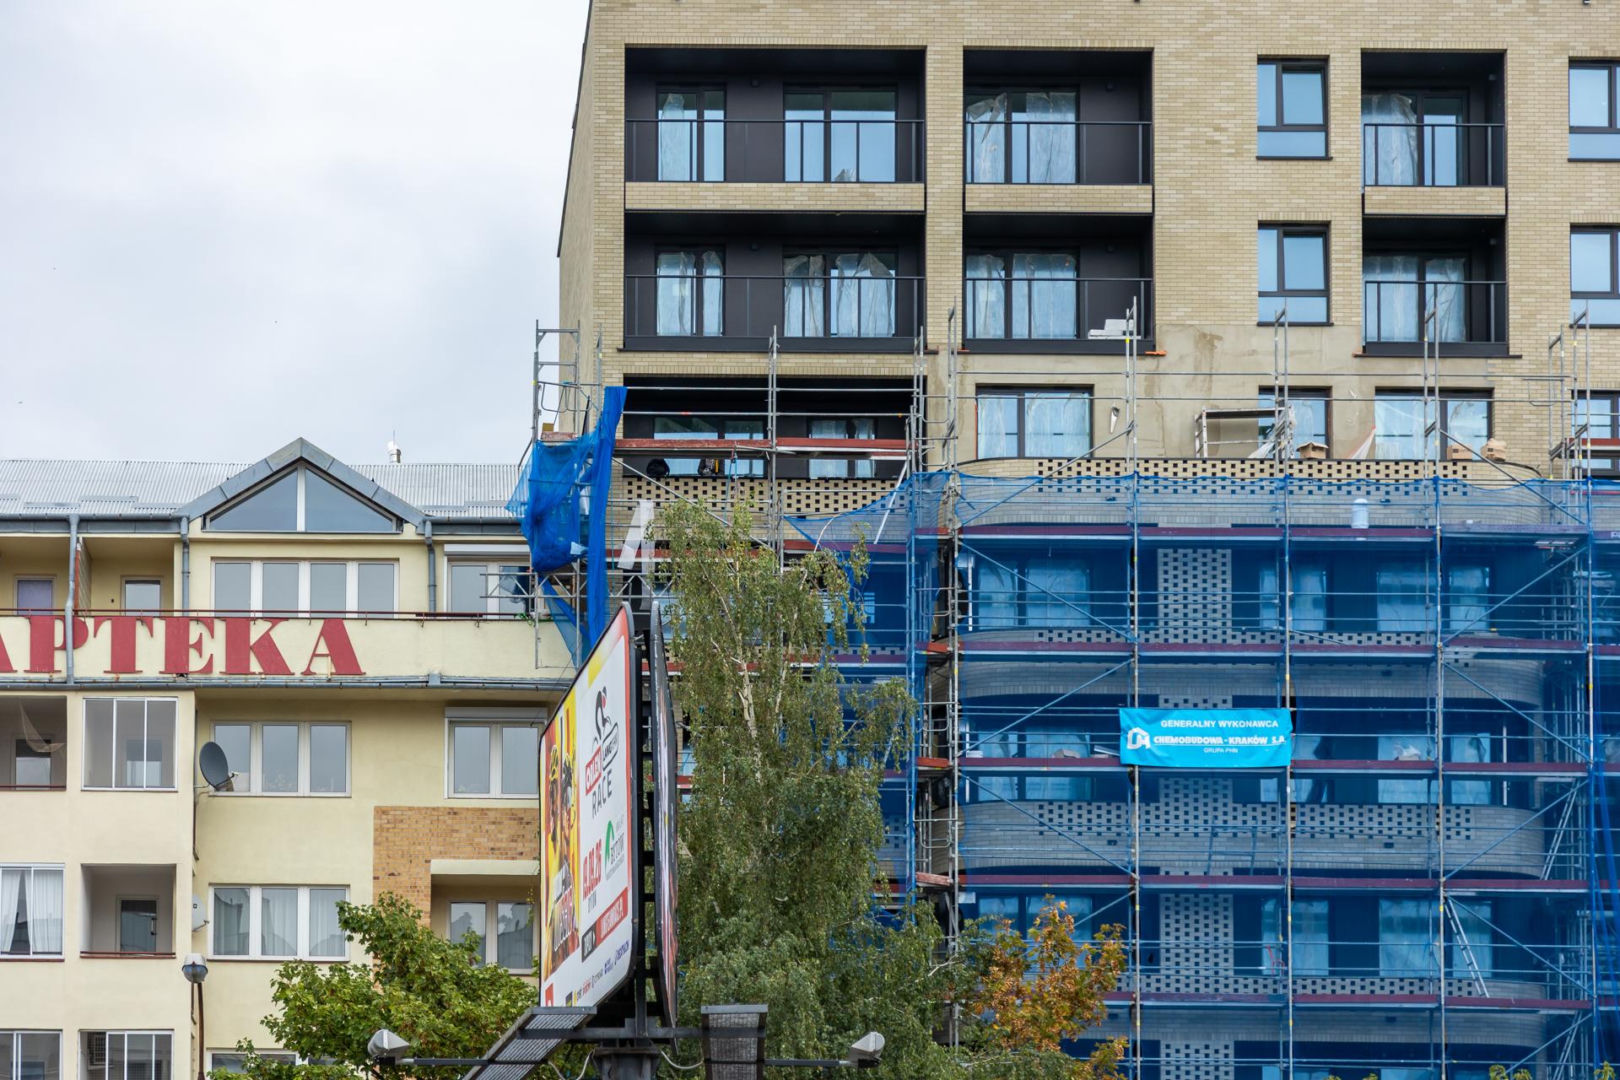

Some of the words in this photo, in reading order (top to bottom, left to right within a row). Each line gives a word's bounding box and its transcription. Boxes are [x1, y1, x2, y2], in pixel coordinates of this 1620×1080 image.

[0, 615, 366, 675] PTEKA
[1160, 720, 1215, 728] GENERALNY
[1218, 720, 1278, 728] WYKONAWCA
[592, 769, 612, 819] RACE
